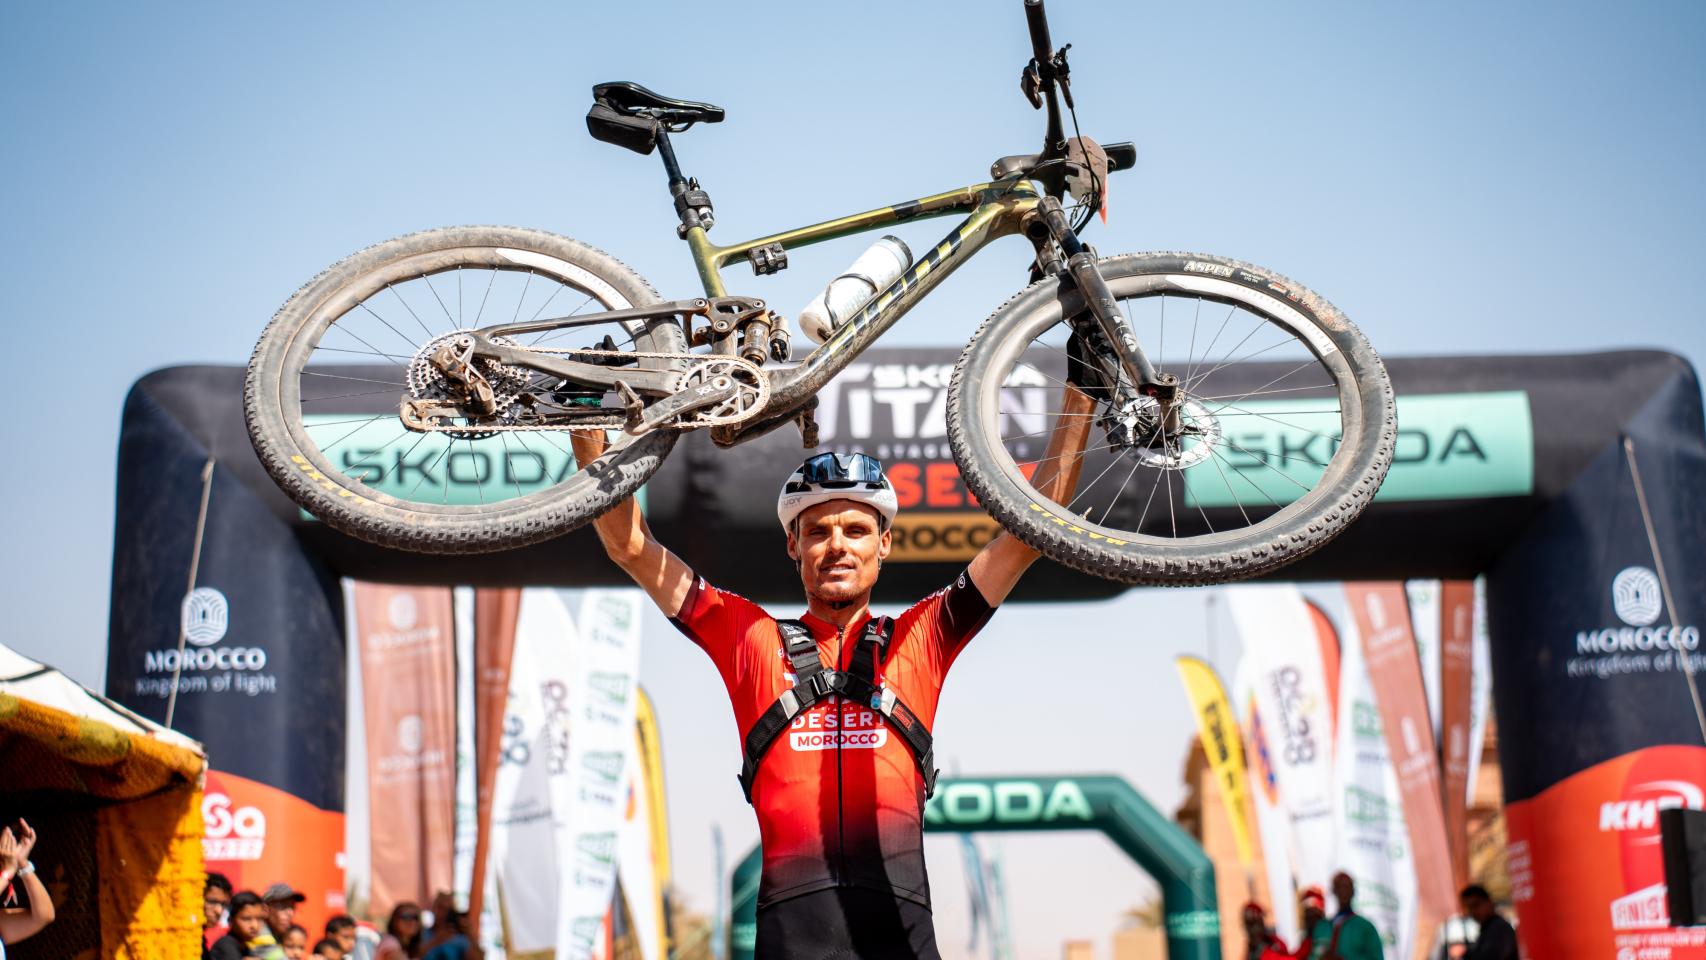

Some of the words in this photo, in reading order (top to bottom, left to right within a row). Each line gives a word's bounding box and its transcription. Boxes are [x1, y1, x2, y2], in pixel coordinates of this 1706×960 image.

[1183, 260, 1236, 278] ASPEN
[1576, 626, 1700, 655] MOROCCO
[144, 646, 267, 674] MOROCCO
[1567, 655, 1650, 680] Kingdom
[212, 674, 232, 694] of
[236, 672, 277, 697] light
[797, 733, 879, 747] MOROCCO
